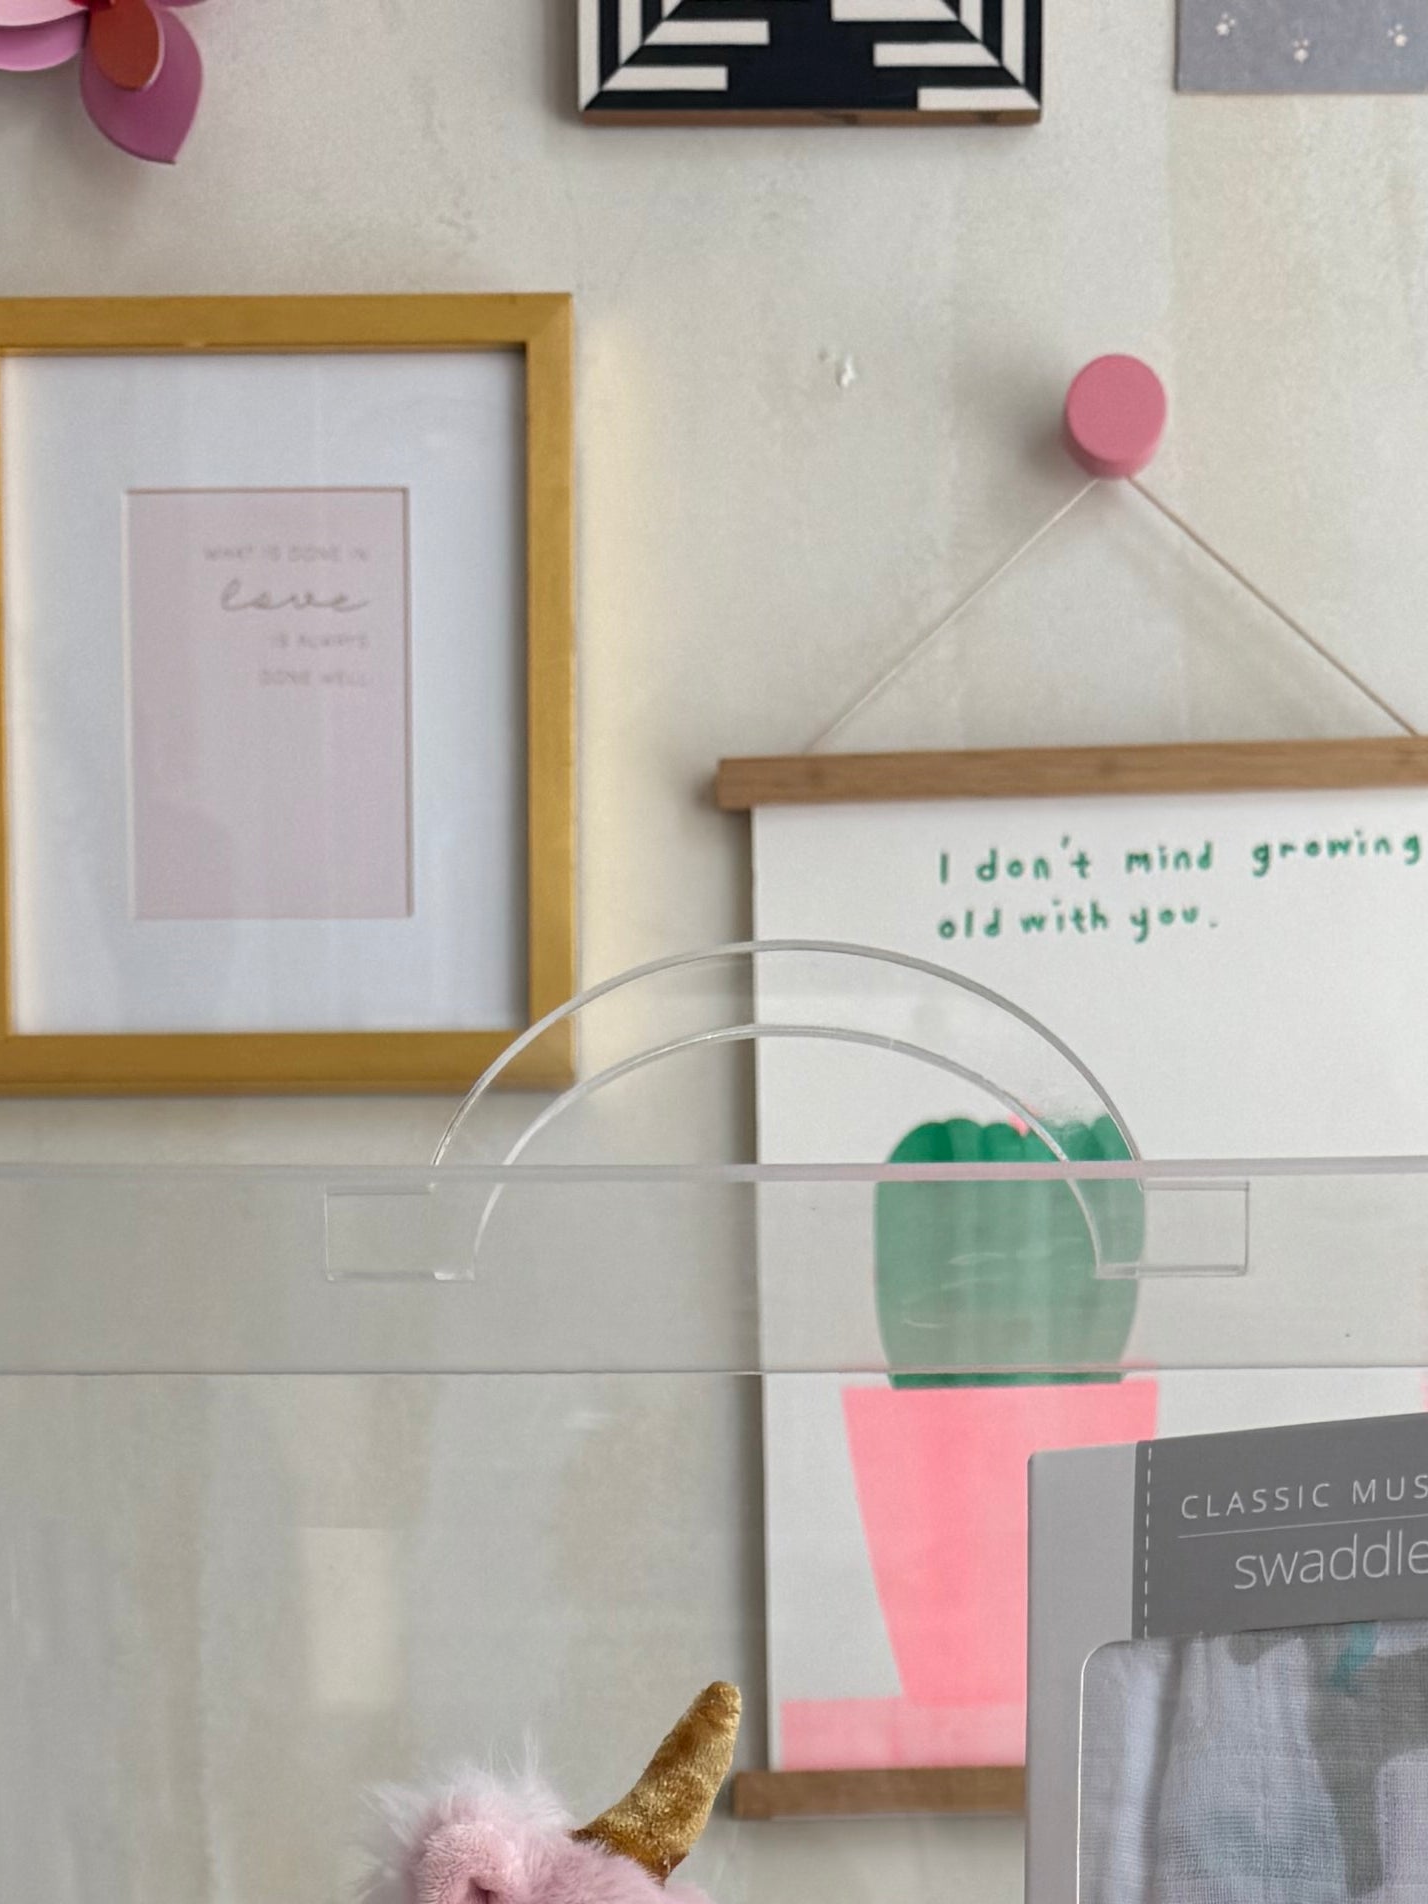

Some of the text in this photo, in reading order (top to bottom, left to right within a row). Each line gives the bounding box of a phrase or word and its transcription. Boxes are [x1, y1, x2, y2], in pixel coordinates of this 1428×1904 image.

[939, 828, 1423, 885] I don't mind growing
[938, 899, 1219, 944] old with you.
[1180, 1482, 1331, 1520] CLASSIC
